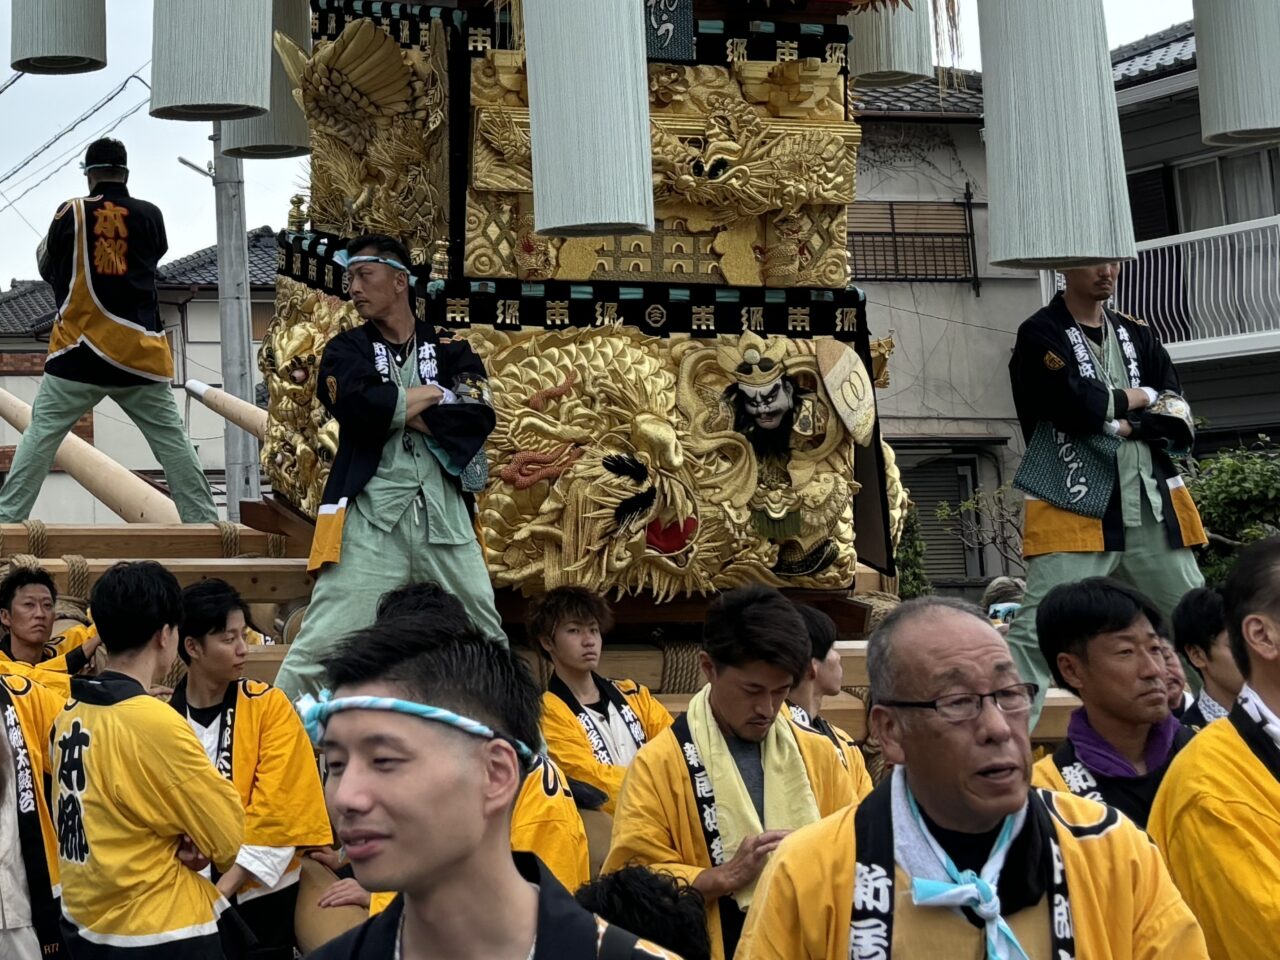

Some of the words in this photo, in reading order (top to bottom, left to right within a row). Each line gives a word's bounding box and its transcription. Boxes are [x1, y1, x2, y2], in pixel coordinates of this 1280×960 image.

[93, 201, 129, 276] 本郷
[418, 342, 438, 384] 本郷
[4, 704, 35, 814] 本郷太鼓台
[620, 704, 645, 747] 本郷
[57, 720, 89, 863] 本郷
